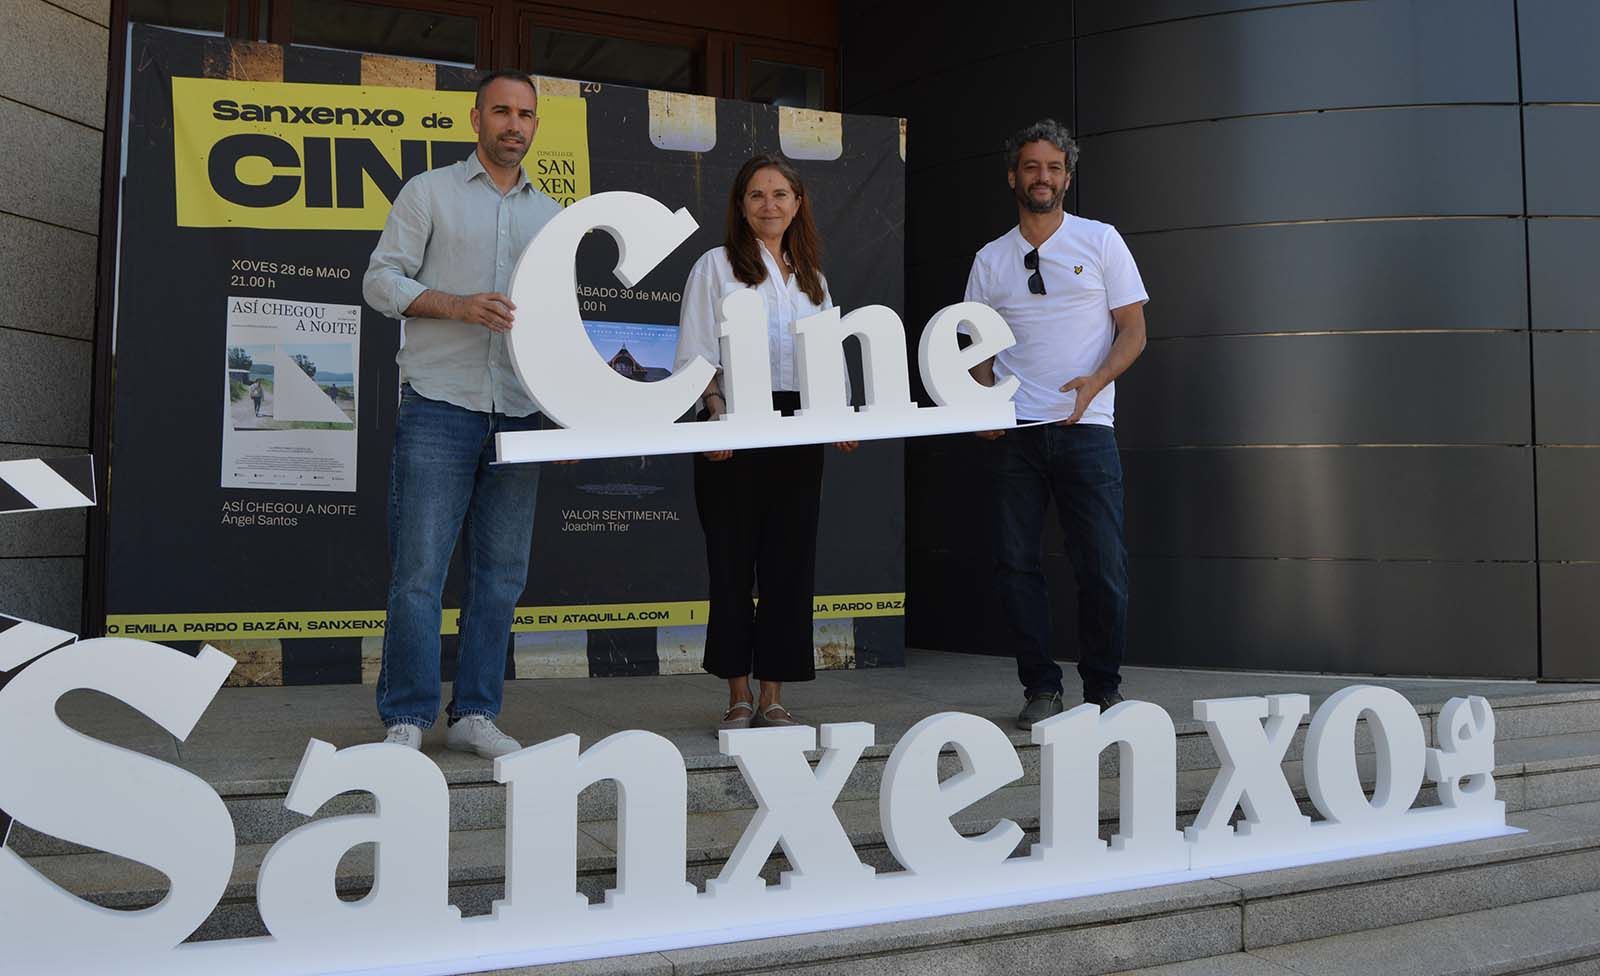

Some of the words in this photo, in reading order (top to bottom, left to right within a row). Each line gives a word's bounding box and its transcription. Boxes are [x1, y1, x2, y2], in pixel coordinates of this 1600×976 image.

[213, 99, 405, 127] Sanxenxo
[421, 113, 454, 129] de
[537, 159, 575, 175] SAN
[538, 178, 576, 194] XEN
[231, 259, 278, 274] XOVES
[280, 264, 296, 275] 28
[298, 266, 314, 277] de
[316, 267, 351, 280] MAIO
[231, 275, 265, 288] 21.00
[267, 278, 276, 288] h
[577, 284, 618, 298] ÁBADO
[620, 289, 634, 299] 30
[635, 290, 649, 301] de
[651, 291, 681, 303] MAIO
[232, 300, 259, 314] ASÍ
[262, 302, 325, 319] CHEGOU
[508, 190, 1022, 429] Cine
[580, 301, 598, 311] .00
[599, 302, 607, 312] h
[295, 320, 306, 332] A
[310, 321, 357, 335] NOITE
[222, 499, 244, 512] ASÍ
[246, 502, 304, 514] CHEGOU
[305, 504, 316, 515] A
[317, 504, 357, 516] NOITE
[221, 512, 255, 527] Ángel
[257, 514, 299, 527] Santos
[561, 510, 600, 521] VALOR
[602, 510, 680, 521] SENTIMENTAL
[561, 521, 606, 532] Joachim
[608, 522, 630, 532] Trier
[832, 602, 873, 612] PARDO
[538, 615, 558, 624] EN
[562, 610, 670, 625] ATAQUILLA.COM
[124, 623, 178, 634] EMILIA
[183, 622, 238, 633] PARDO
[243, 619, 303, 633] BAZÁN,
[307, 619, 387, 630] SANXENX
[0, 638, 1427, 950] Sanxenxo
